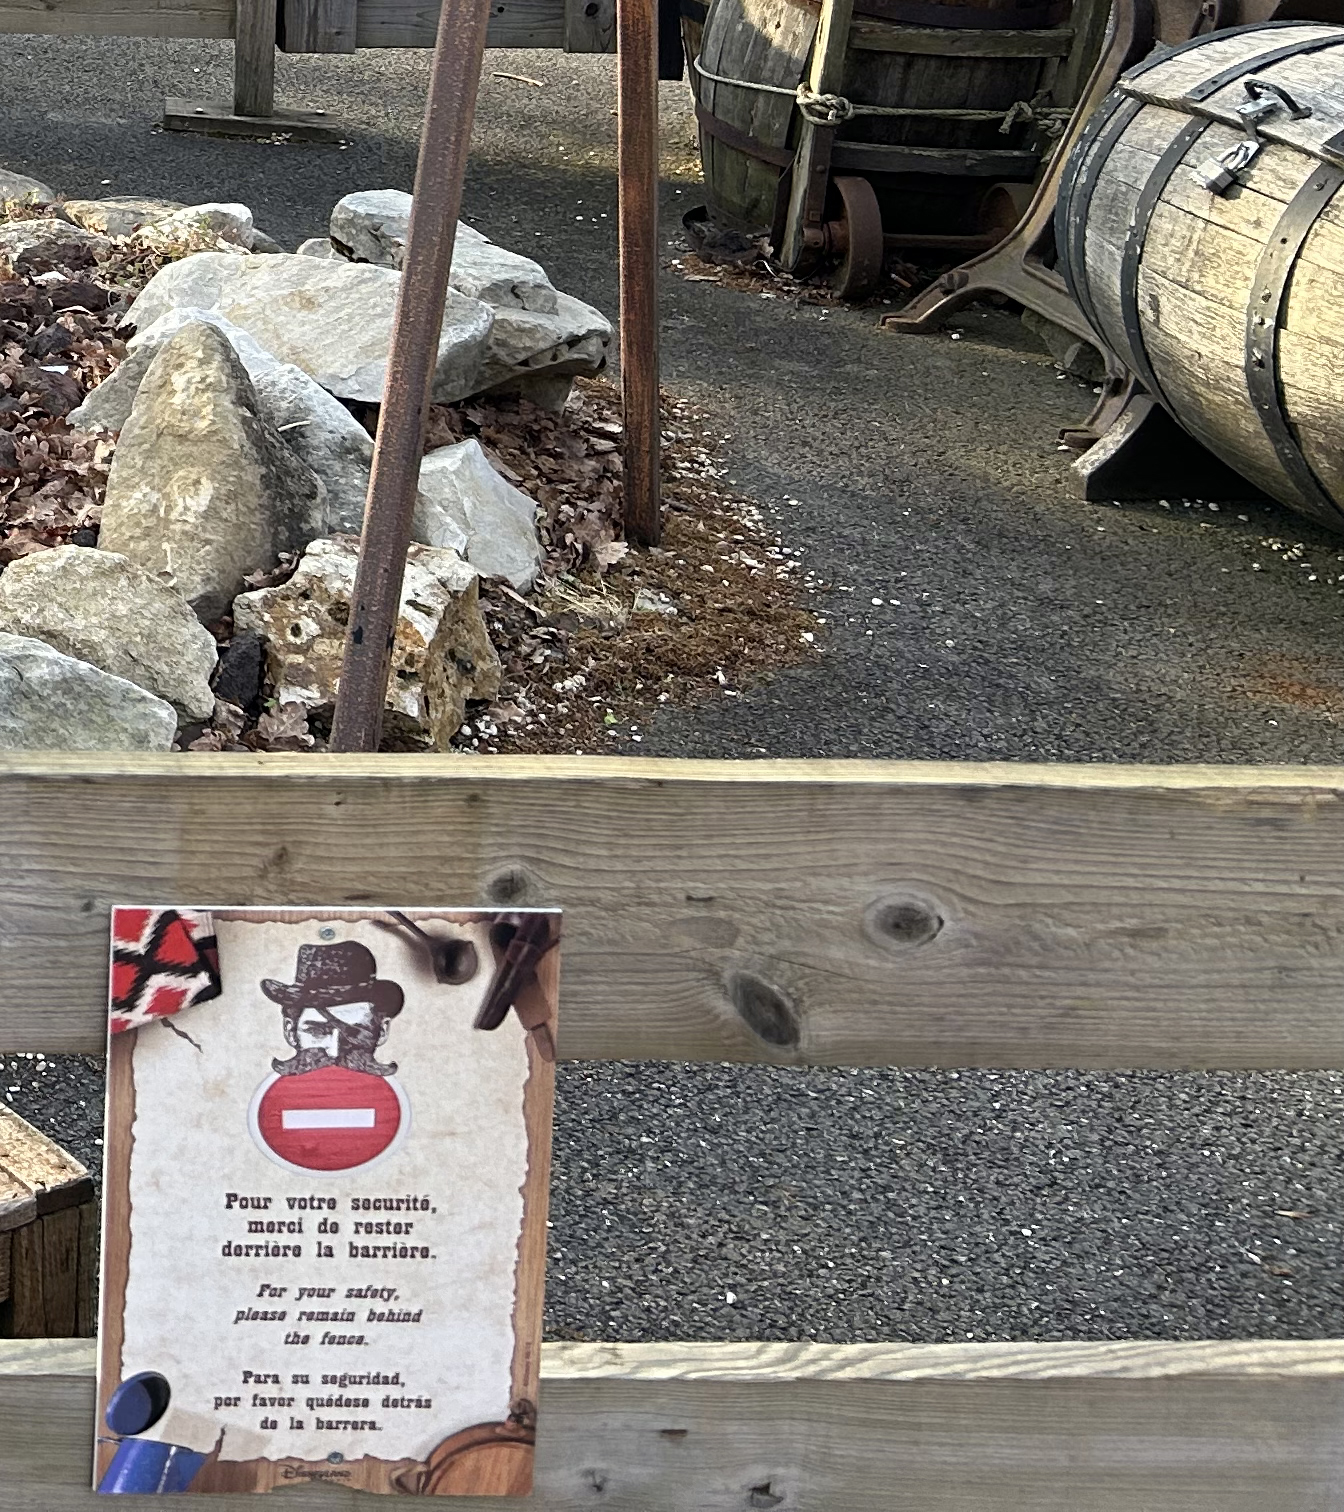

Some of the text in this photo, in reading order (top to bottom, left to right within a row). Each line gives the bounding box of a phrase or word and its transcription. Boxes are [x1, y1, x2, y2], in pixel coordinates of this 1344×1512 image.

[224, 1192, 272, 1210] Pour
[285, 1192, 337, 1211] votre
[247, 1217, 413, 1236] merci de rester
[221, 1240, 437, 1260] derrière la barrière.
[256, 1284, 400, 1302] For your safety,
[233, 1307, 423, 1325] please remain behind
[284, 1331, 369, 1346] the fence.
[242, 1370, 406, 1388] Para su seguridad,
[213, 1395, 241, 1410] por
[252, 1394, 295, 1408] favor
[260, 1417, 278, 1430] de
[289, 1417, 304, 1430] la
